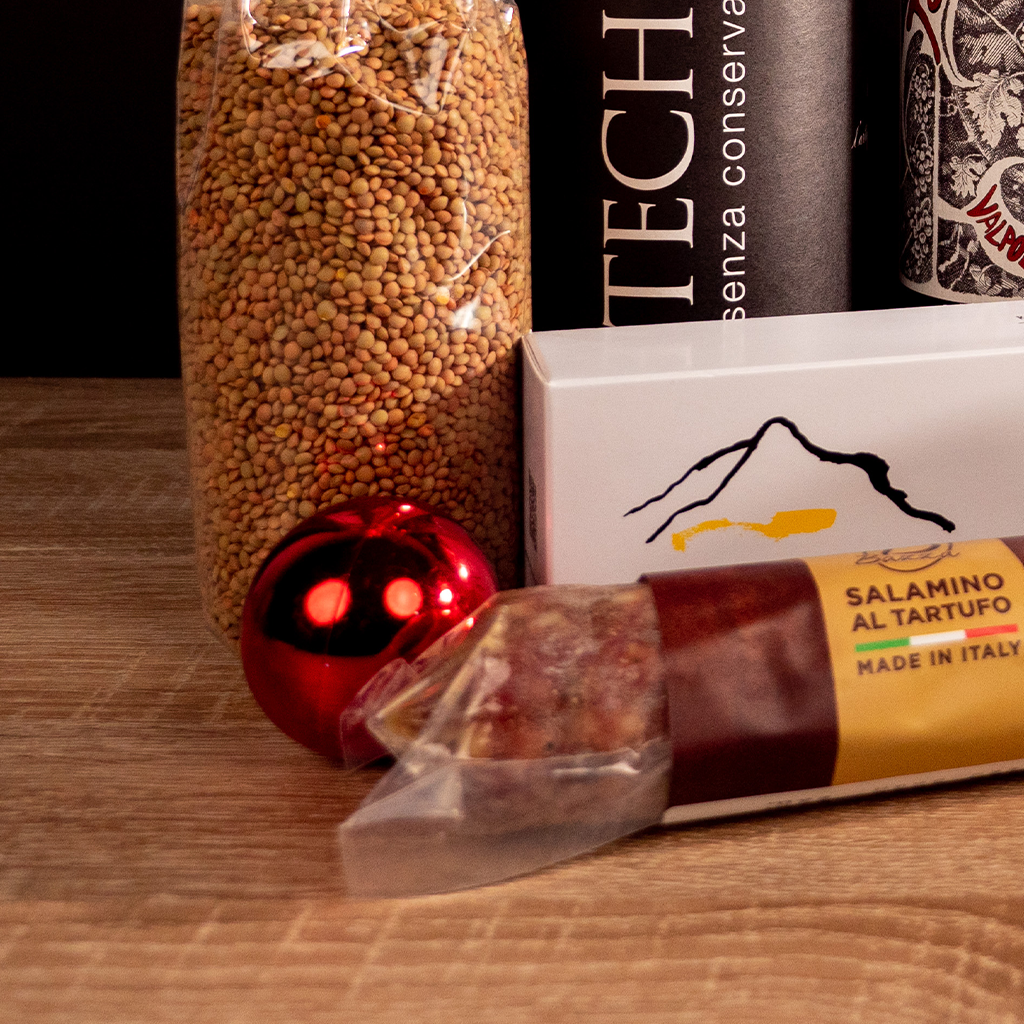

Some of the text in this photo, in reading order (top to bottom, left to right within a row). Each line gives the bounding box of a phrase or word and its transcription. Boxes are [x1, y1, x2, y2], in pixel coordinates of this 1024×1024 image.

[722, 204, 746, 324] senza
[845, 572, 1005, 607] SALAMINO
[852, 596, 1012, 632] AL TARTUFO
[857, 639, 1021, 676] MADE IN ITALY
